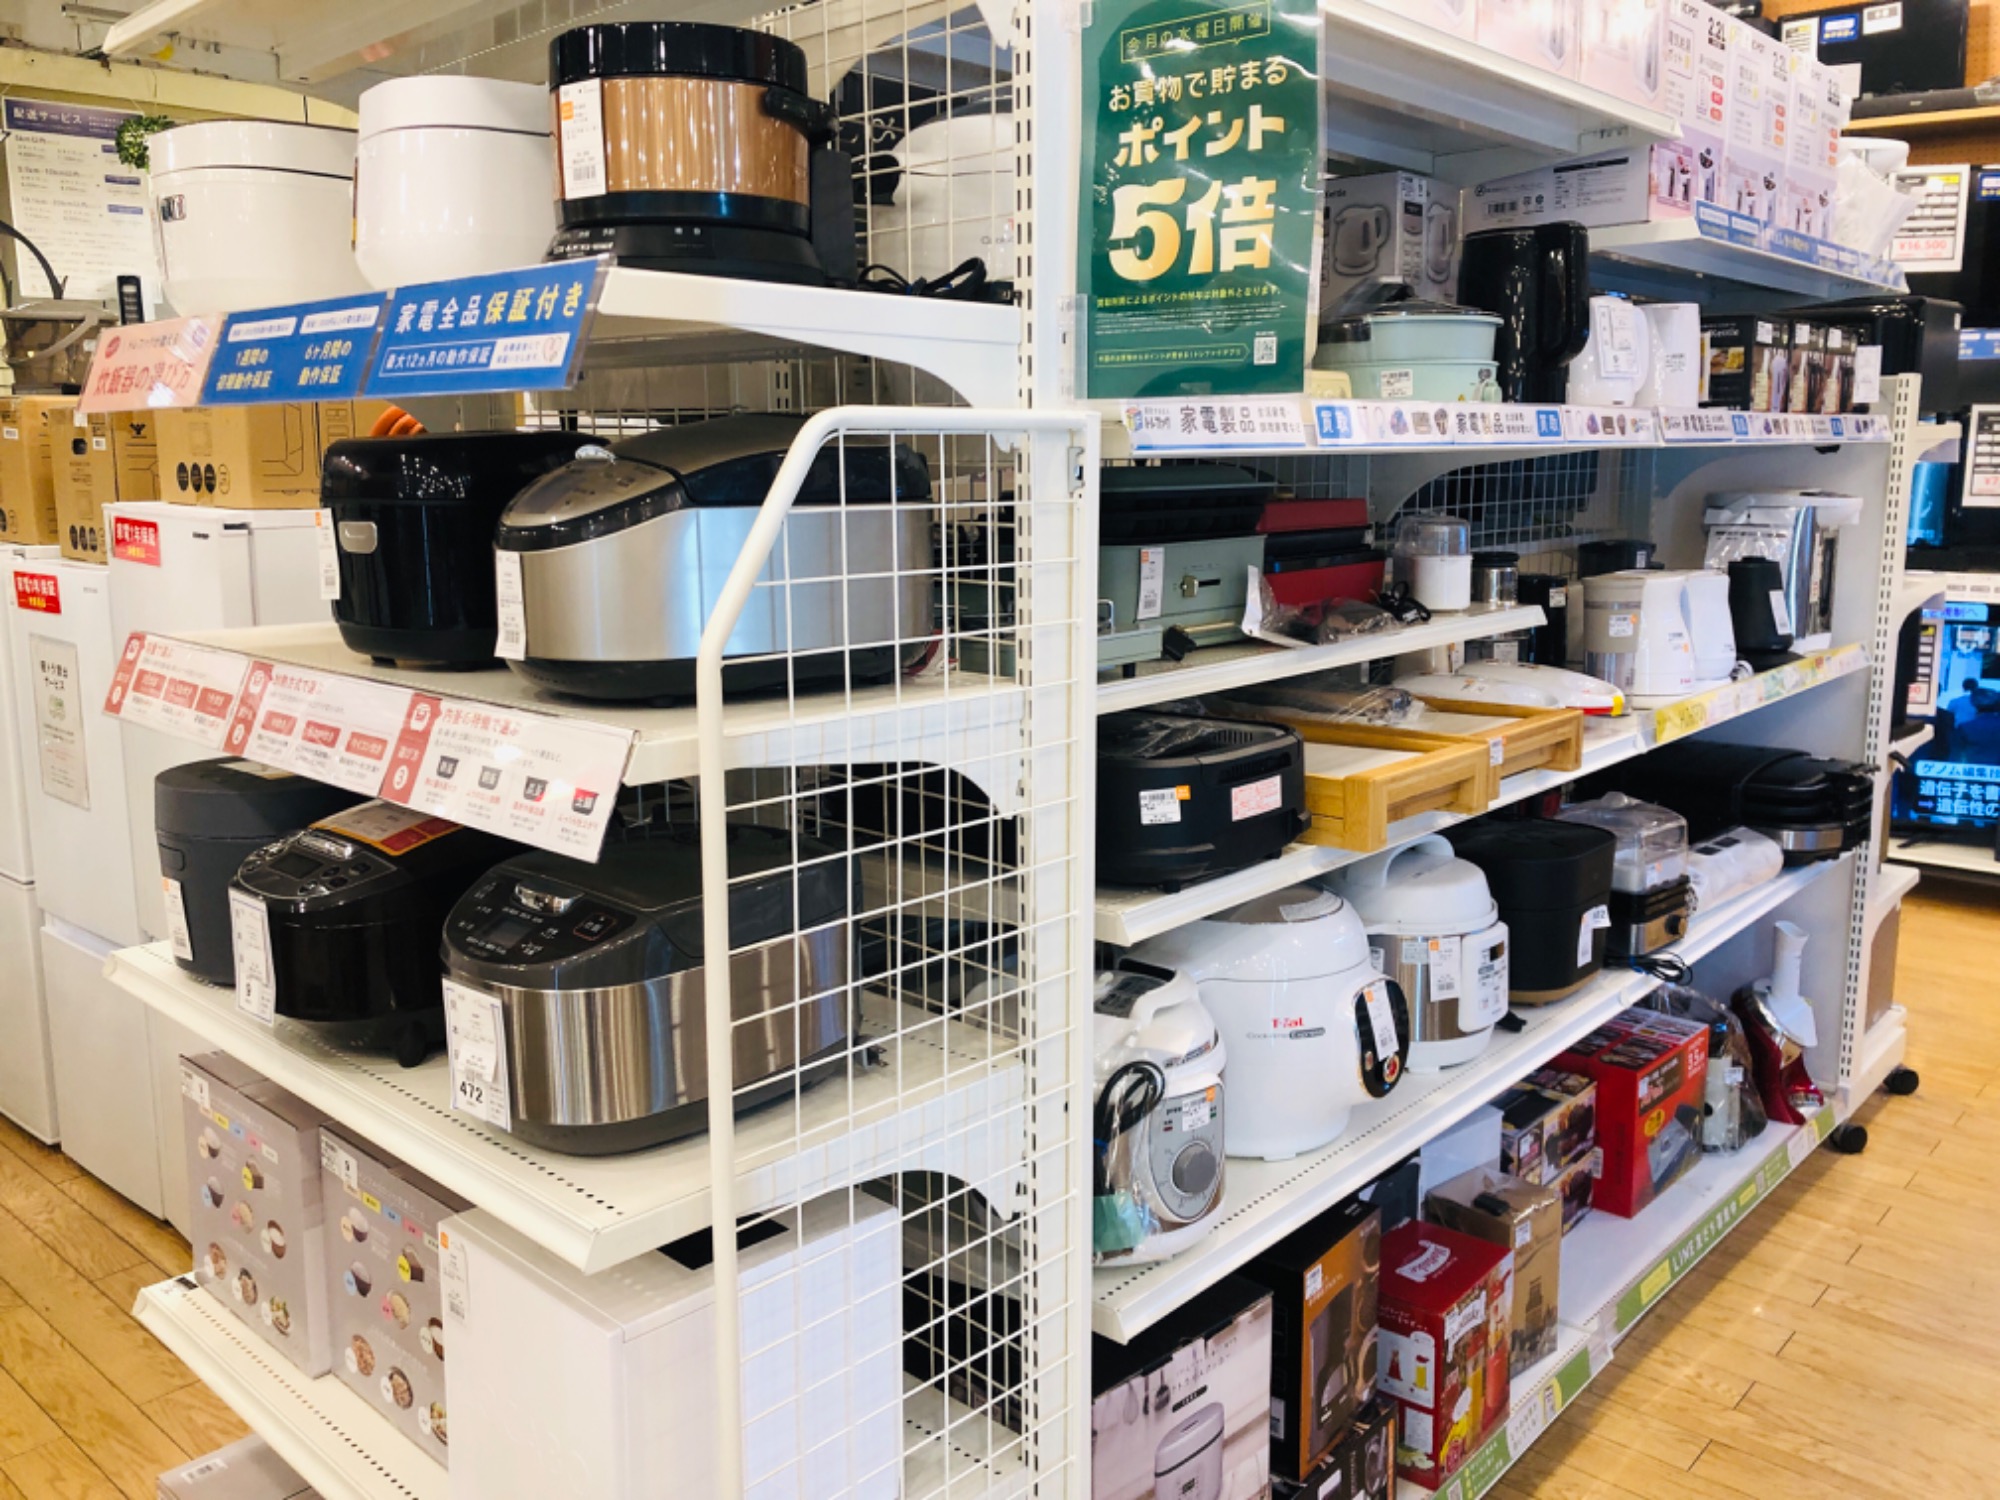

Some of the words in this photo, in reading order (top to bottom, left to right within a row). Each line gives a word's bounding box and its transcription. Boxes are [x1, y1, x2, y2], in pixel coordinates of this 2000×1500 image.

[1126, 11, 1263, 54] 今月の水曜日開催
[1109, 55, 1287, 112] お買物で貯まる
[13, 107, 82, 125] 配送サービス
[1113, 103, 1285, 168] ポイント
[1108, 176, 1278, 281] 5倍
[394, 281, 583, 334] 家電全品保証付き
[1180, 404, 1255, 435] 家電製品
[1320, 409, 1352, 434] 買取
[460, 1081, 484, 1104] 472
